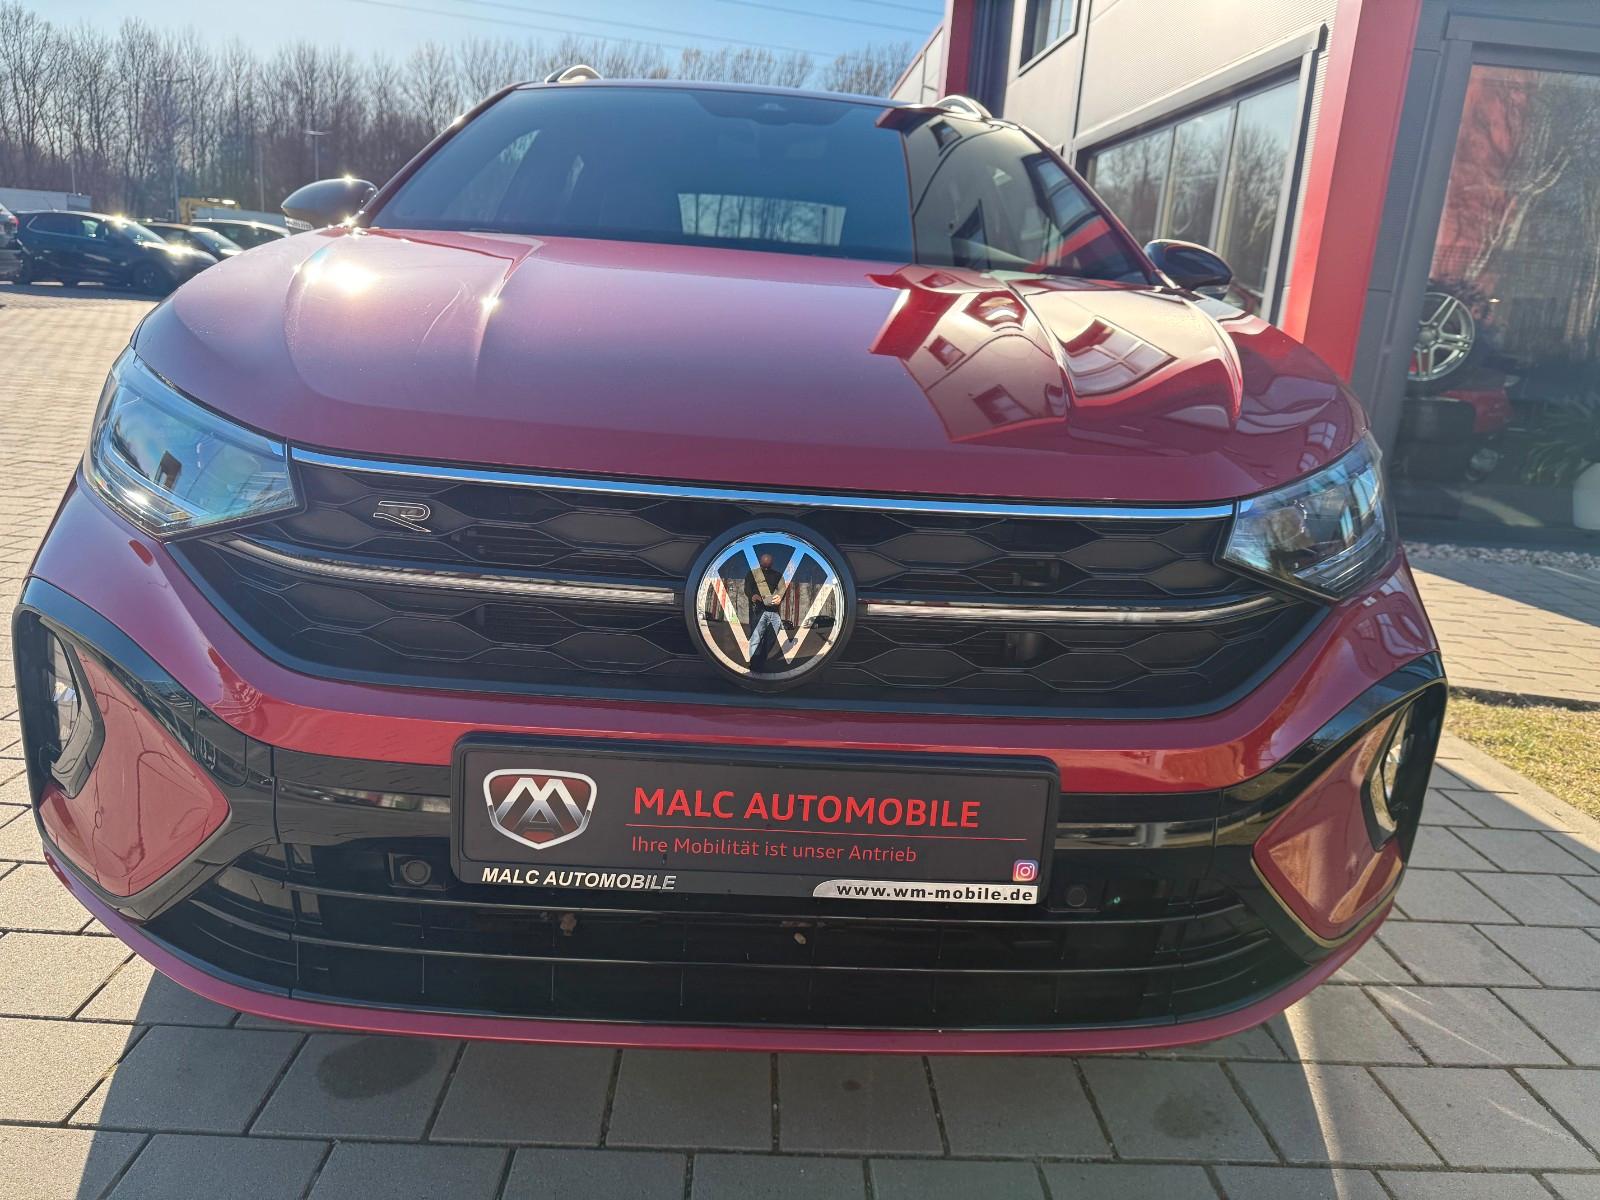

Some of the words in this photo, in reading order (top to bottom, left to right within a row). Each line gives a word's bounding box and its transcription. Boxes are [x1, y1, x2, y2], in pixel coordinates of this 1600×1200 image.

[373, 500, 431, 533] R
[634, 787, 734, 819] MALC
[744, 793, 981, 828] AUTOMOBILE
[631, 836, 668, 854] Ihre
[674, 838, 759, 857] Mobilität
[764, 842, 786, 857] ist
[792, 845, 844, 860] unser
[849, 845, 917, 863] Antrieb
[481, 866, 539, 884] MALC
[543, 870, 677, 891] AUTOMOBILE
[836, 884, 1034, 902] www.wm-mobile.de
